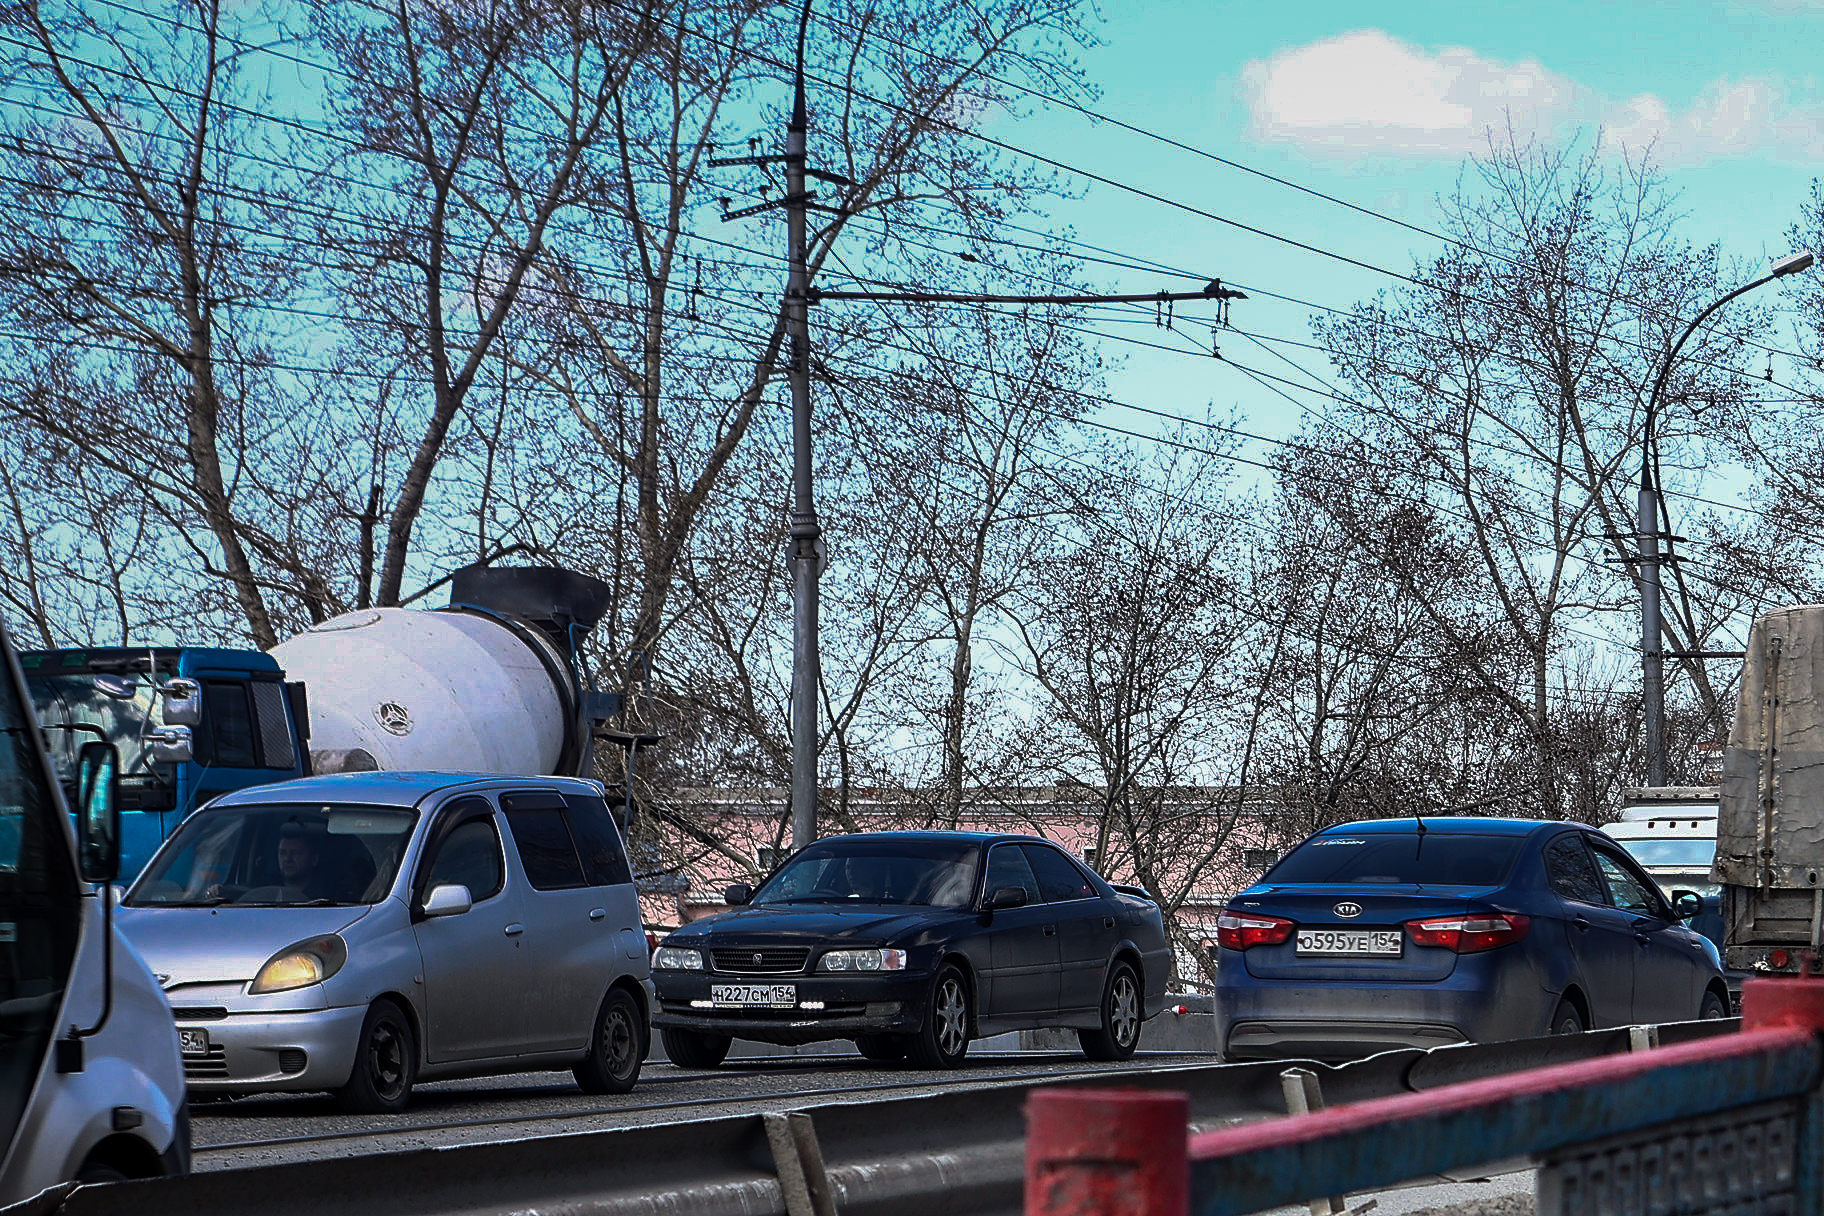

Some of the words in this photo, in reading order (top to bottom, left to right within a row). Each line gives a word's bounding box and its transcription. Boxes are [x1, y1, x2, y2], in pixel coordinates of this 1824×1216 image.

[1337, 906, 1357, 914] KIA
[1302, 932, 1368, 950] О595УЕ
[1371, 932, 1397, 946] 154
[716, 986, 770, 1001] Н227СМ
[771, 986, 794, 1000] 154
